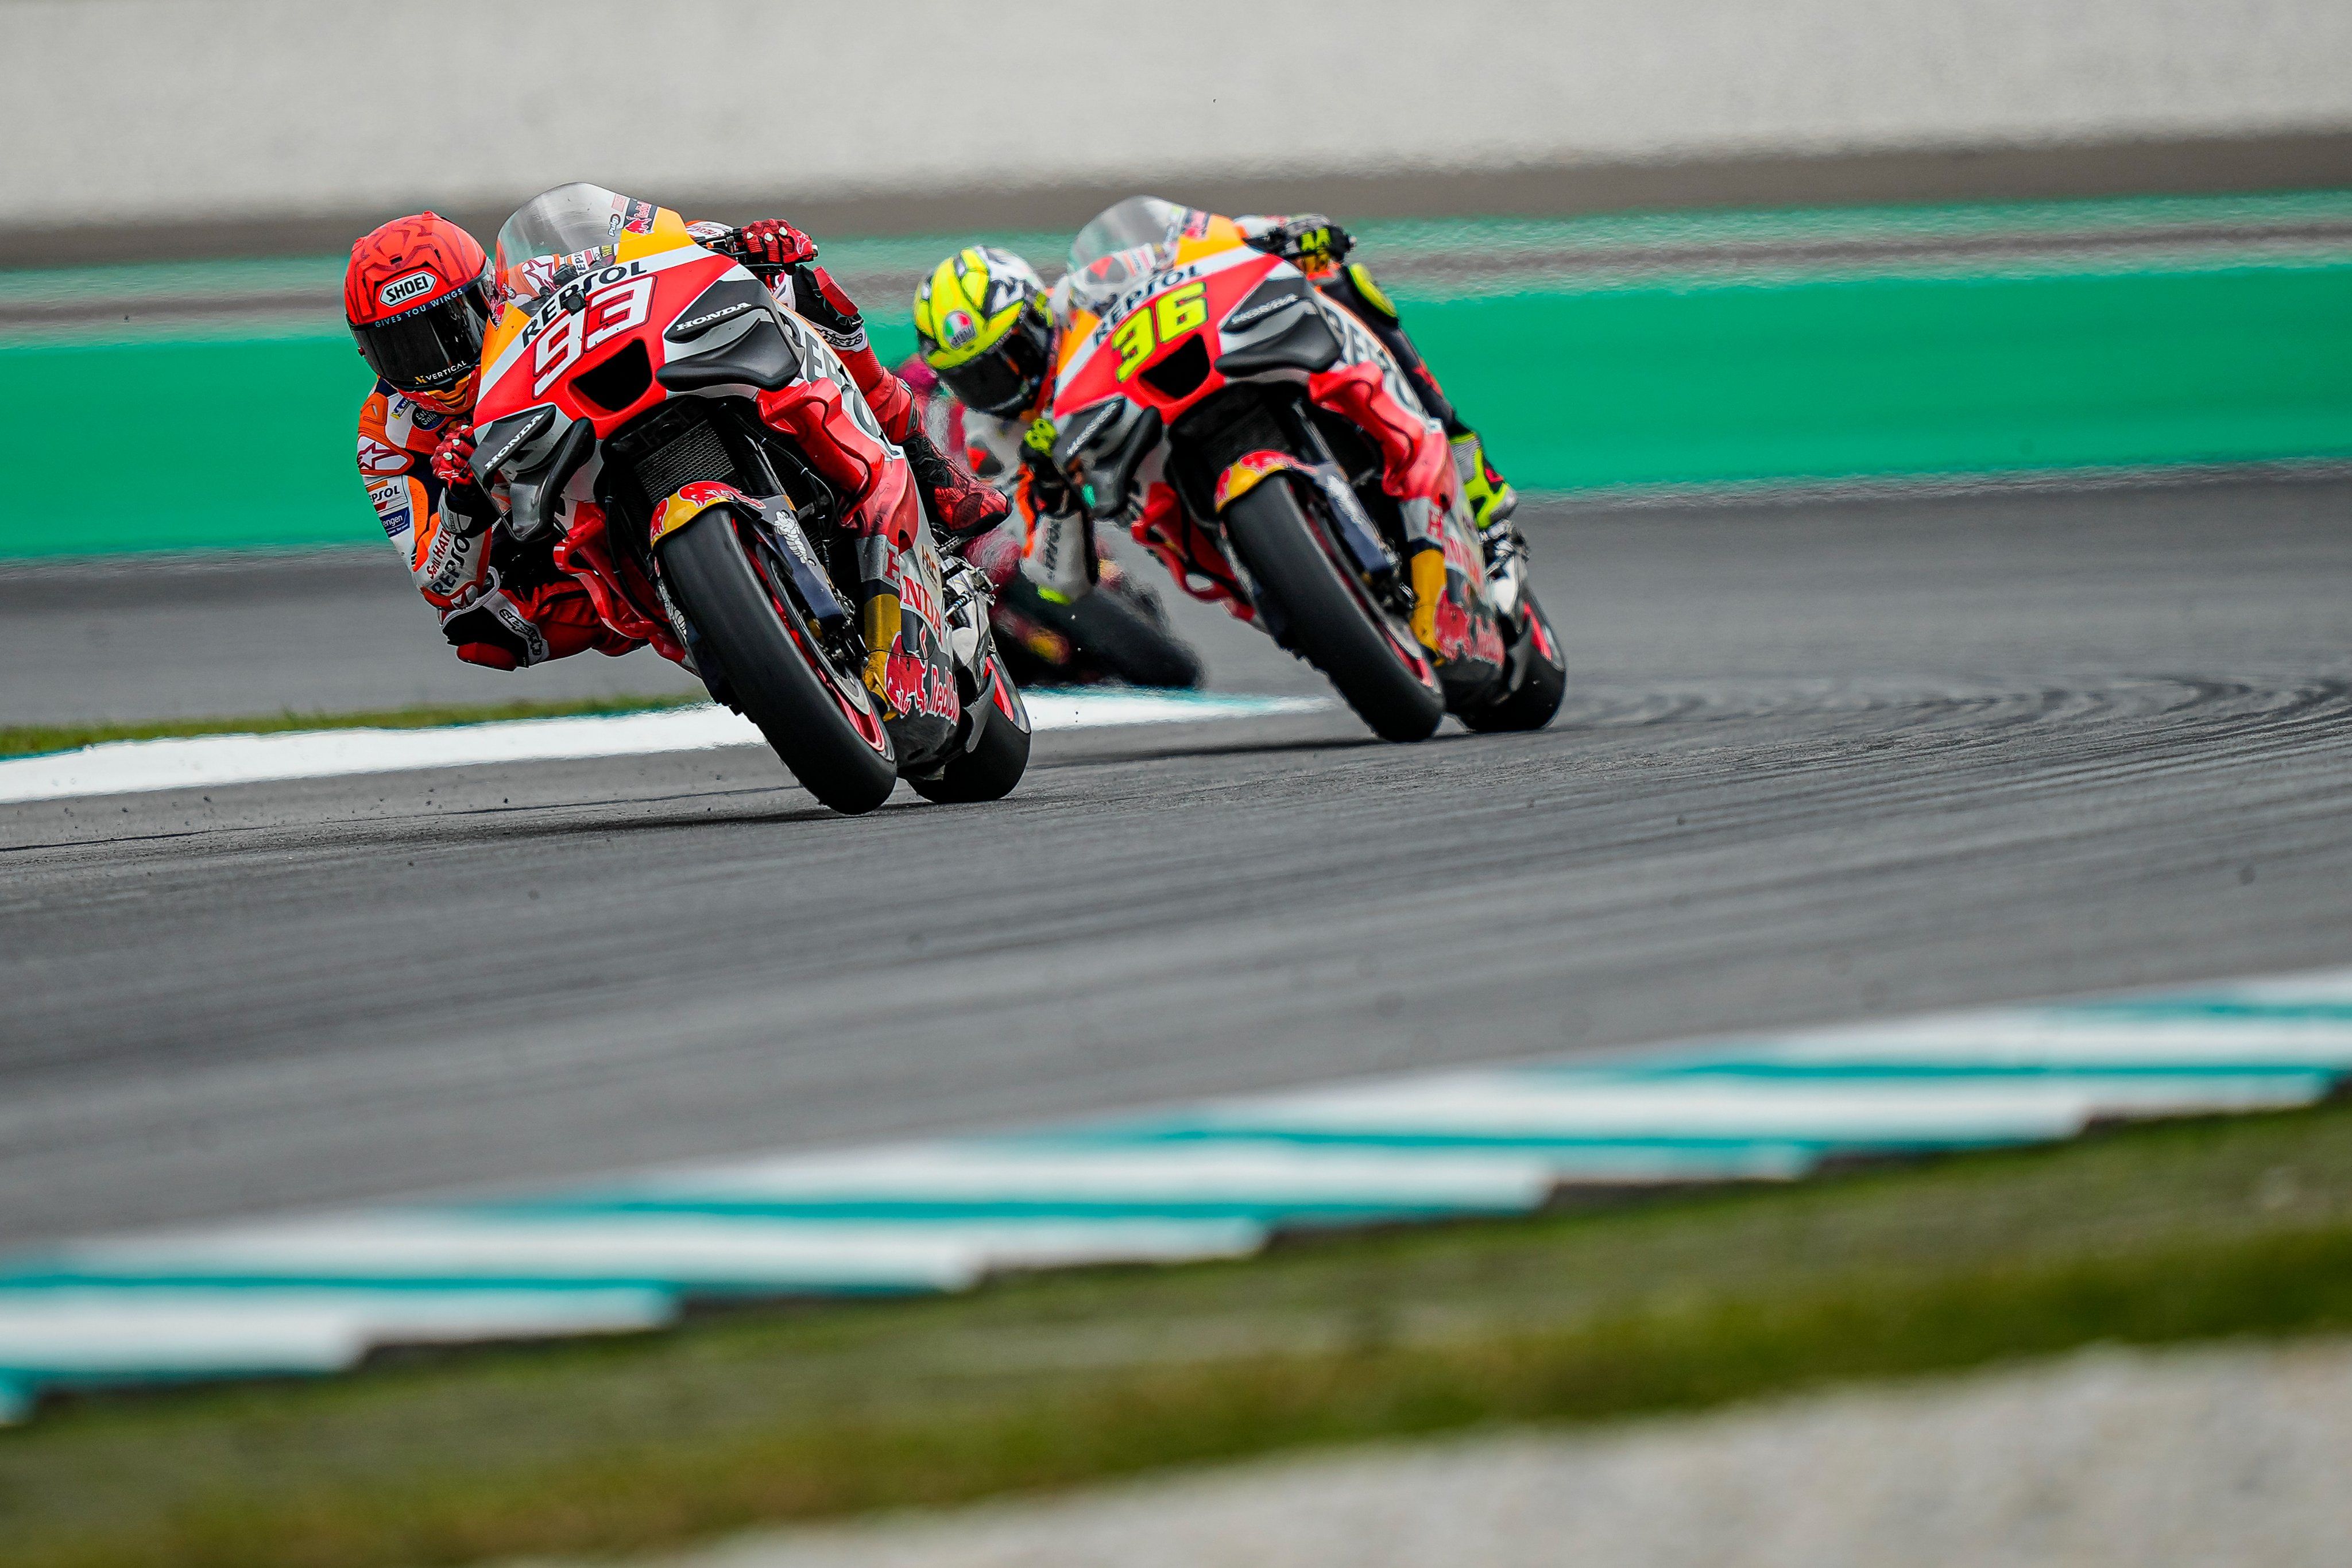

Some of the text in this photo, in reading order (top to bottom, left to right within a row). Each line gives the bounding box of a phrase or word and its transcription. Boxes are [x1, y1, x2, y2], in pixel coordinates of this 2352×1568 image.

[374, 288, 463, 328] GIVES YOU WINGS
[386, 276, 429, 303] SHOEI
[522, 261, 647, 348] REPSOL
[533, 274, 657, 400] 93
[675, 301, 752, 332] HONDA
[1112, 281, 1209, 384] 36
[425, 360, 467, 381] VERTICAL
[483, 413, 545, 470] HONDA
[369, 485, 400, 504] PSOL
[381, 514, 403, 527] engen
[431, 534, 471, 594] REPSO
[884, 548, 943, 648] HNDA
